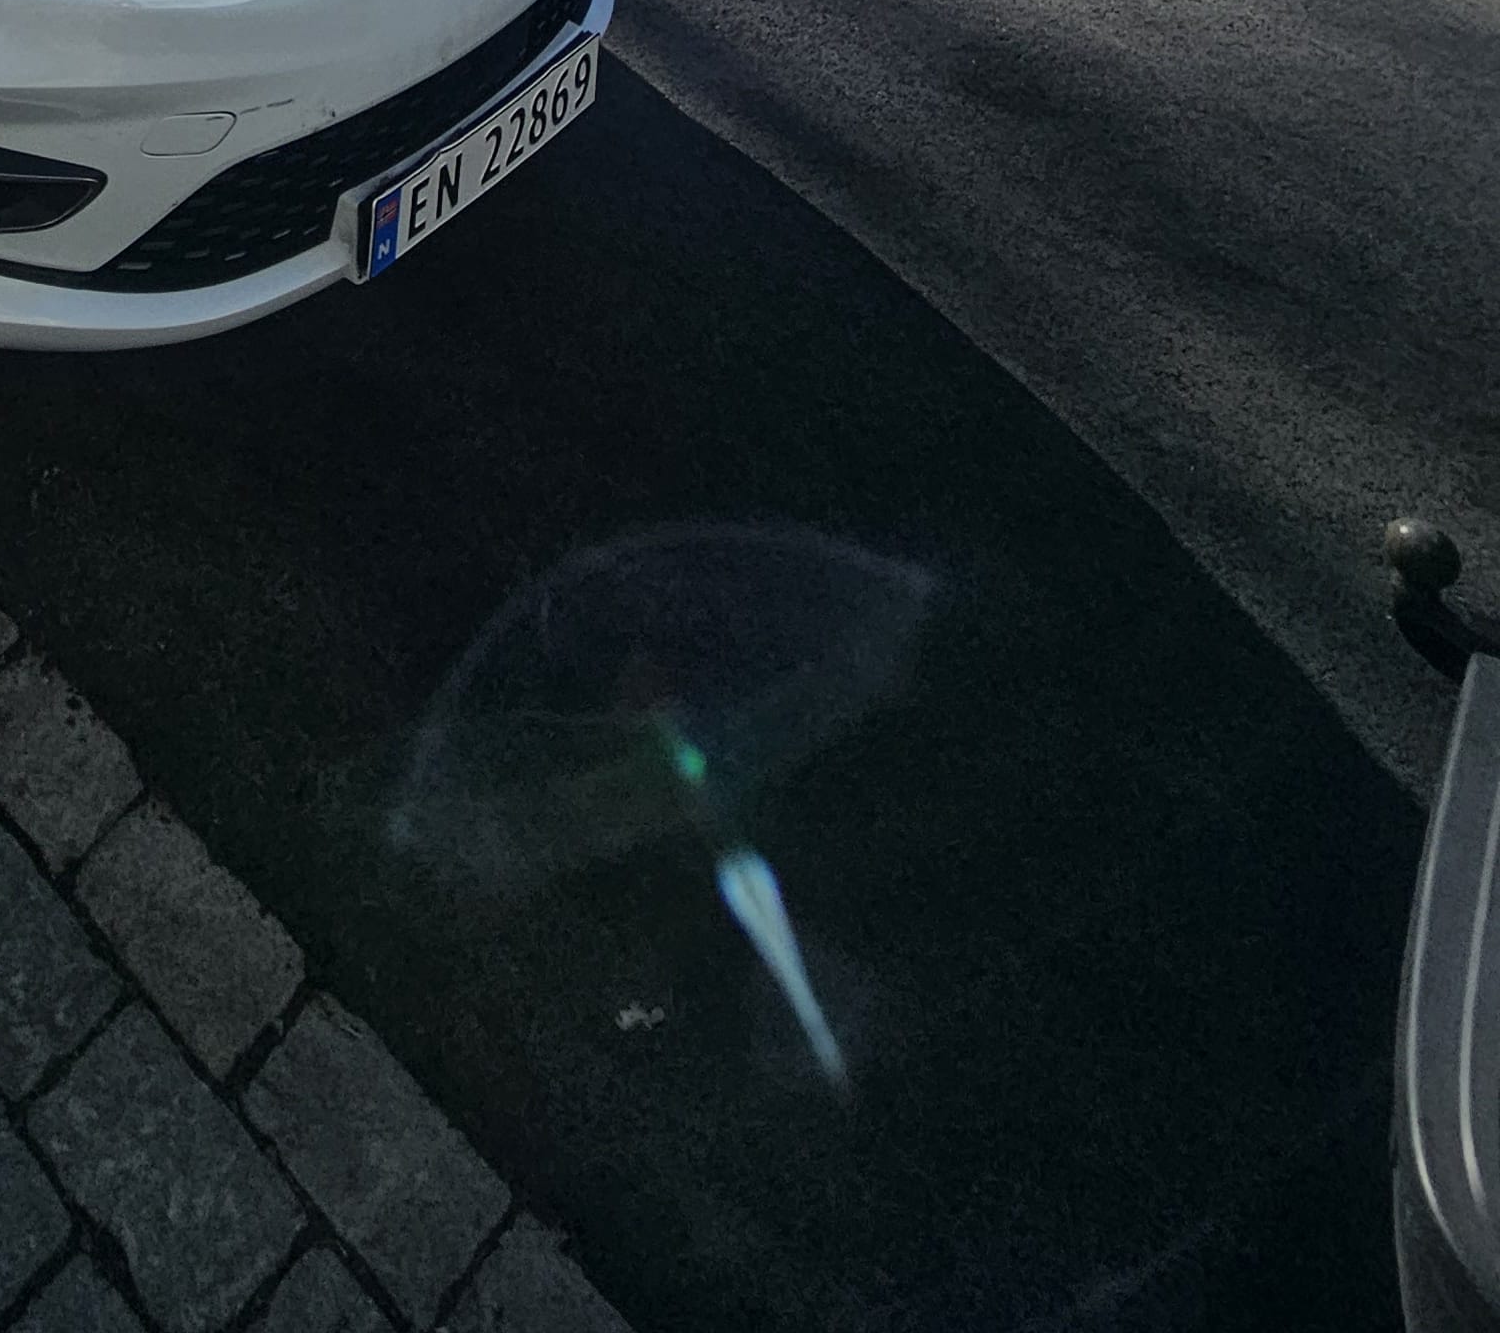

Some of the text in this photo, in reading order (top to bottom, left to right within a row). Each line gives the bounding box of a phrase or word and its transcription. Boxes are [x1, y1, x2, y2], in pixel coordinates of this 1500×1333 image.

[408, 52, 591, 242] EN 22869
[378, 239, 391, 260] N
